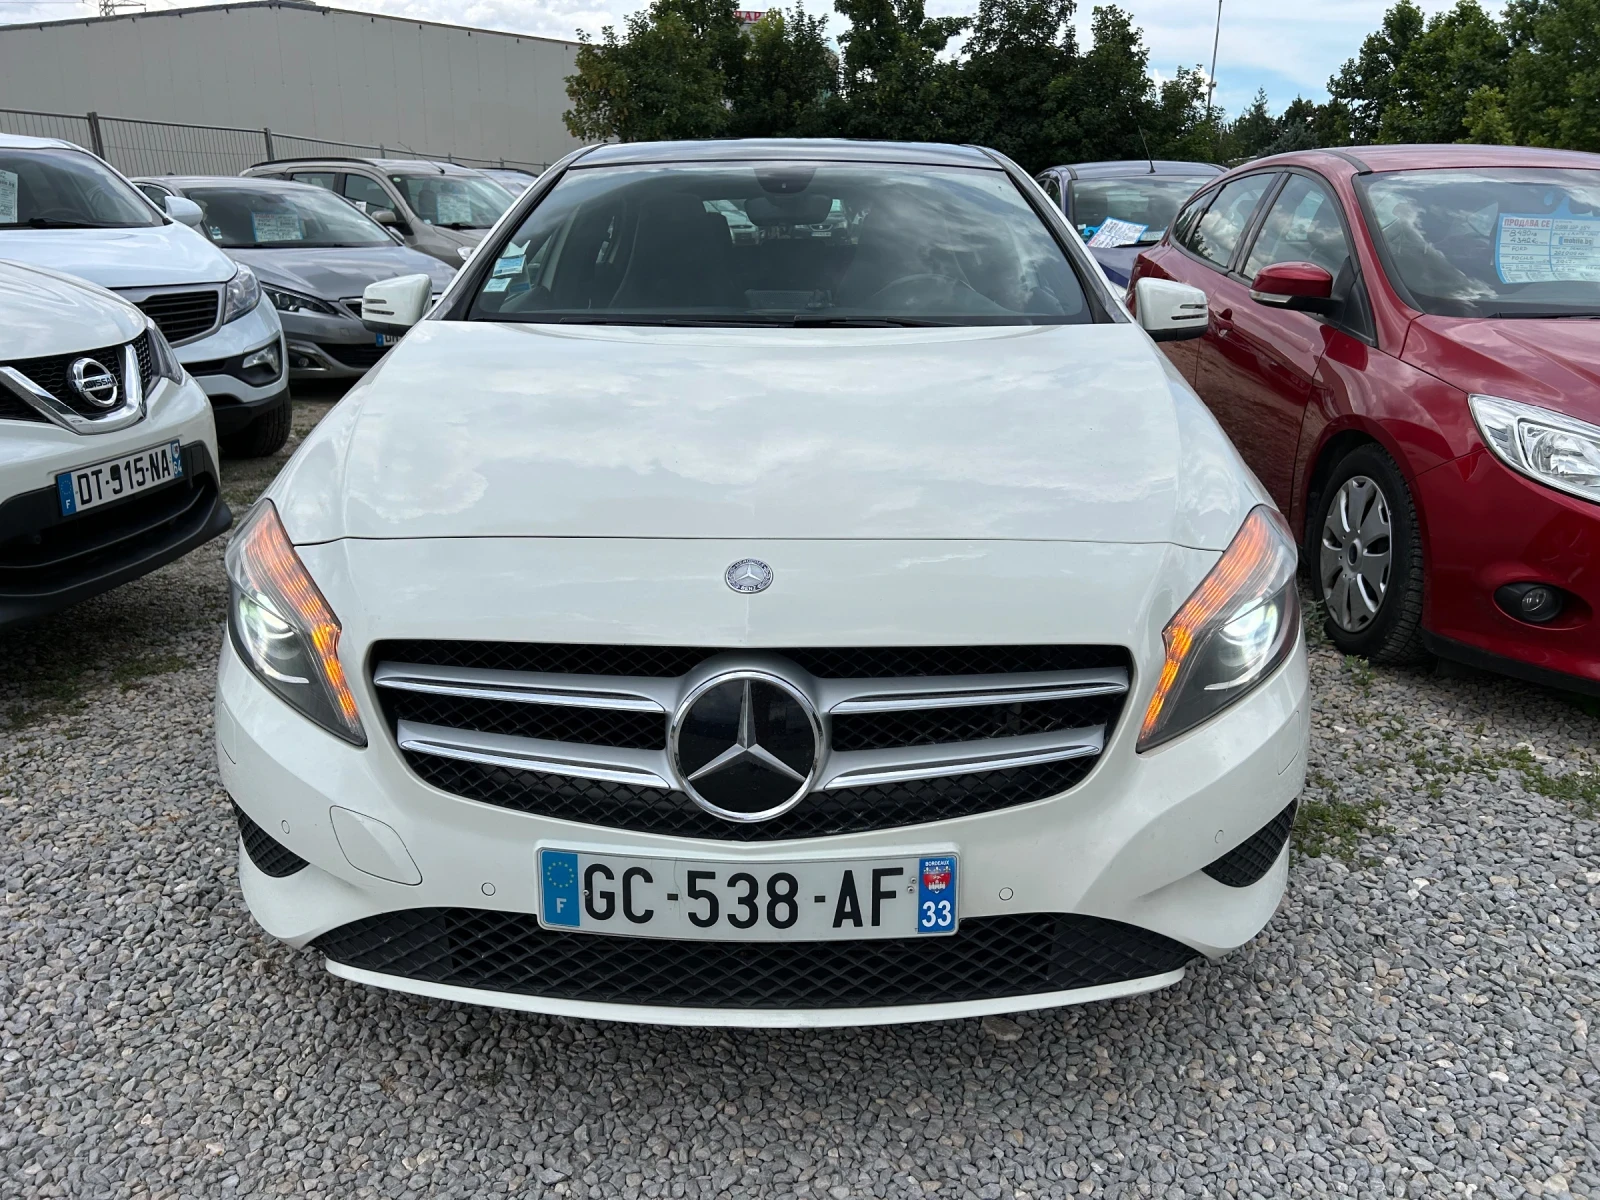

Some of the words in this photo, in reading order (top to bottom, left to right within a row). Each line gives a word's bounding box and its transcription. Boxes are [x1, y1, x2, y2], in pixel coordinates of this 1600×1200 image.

[1504, 219, 1539, 227] ПРОДАВА
[1541, 220, 1551, 228] СЕ
[1563, 236, 1593, 245] mobile.bg
[82, 374, 117, 390] NISSAN
[173, 460, 183, 474] 64
[77, 449, 171, 505] DT-915-NA
[65, 499, 71, 509] F
[583, 863, 904, 930] GC-538-AF
[556, 897, 567, 914] F
[921, 899, 952, 928] 33
